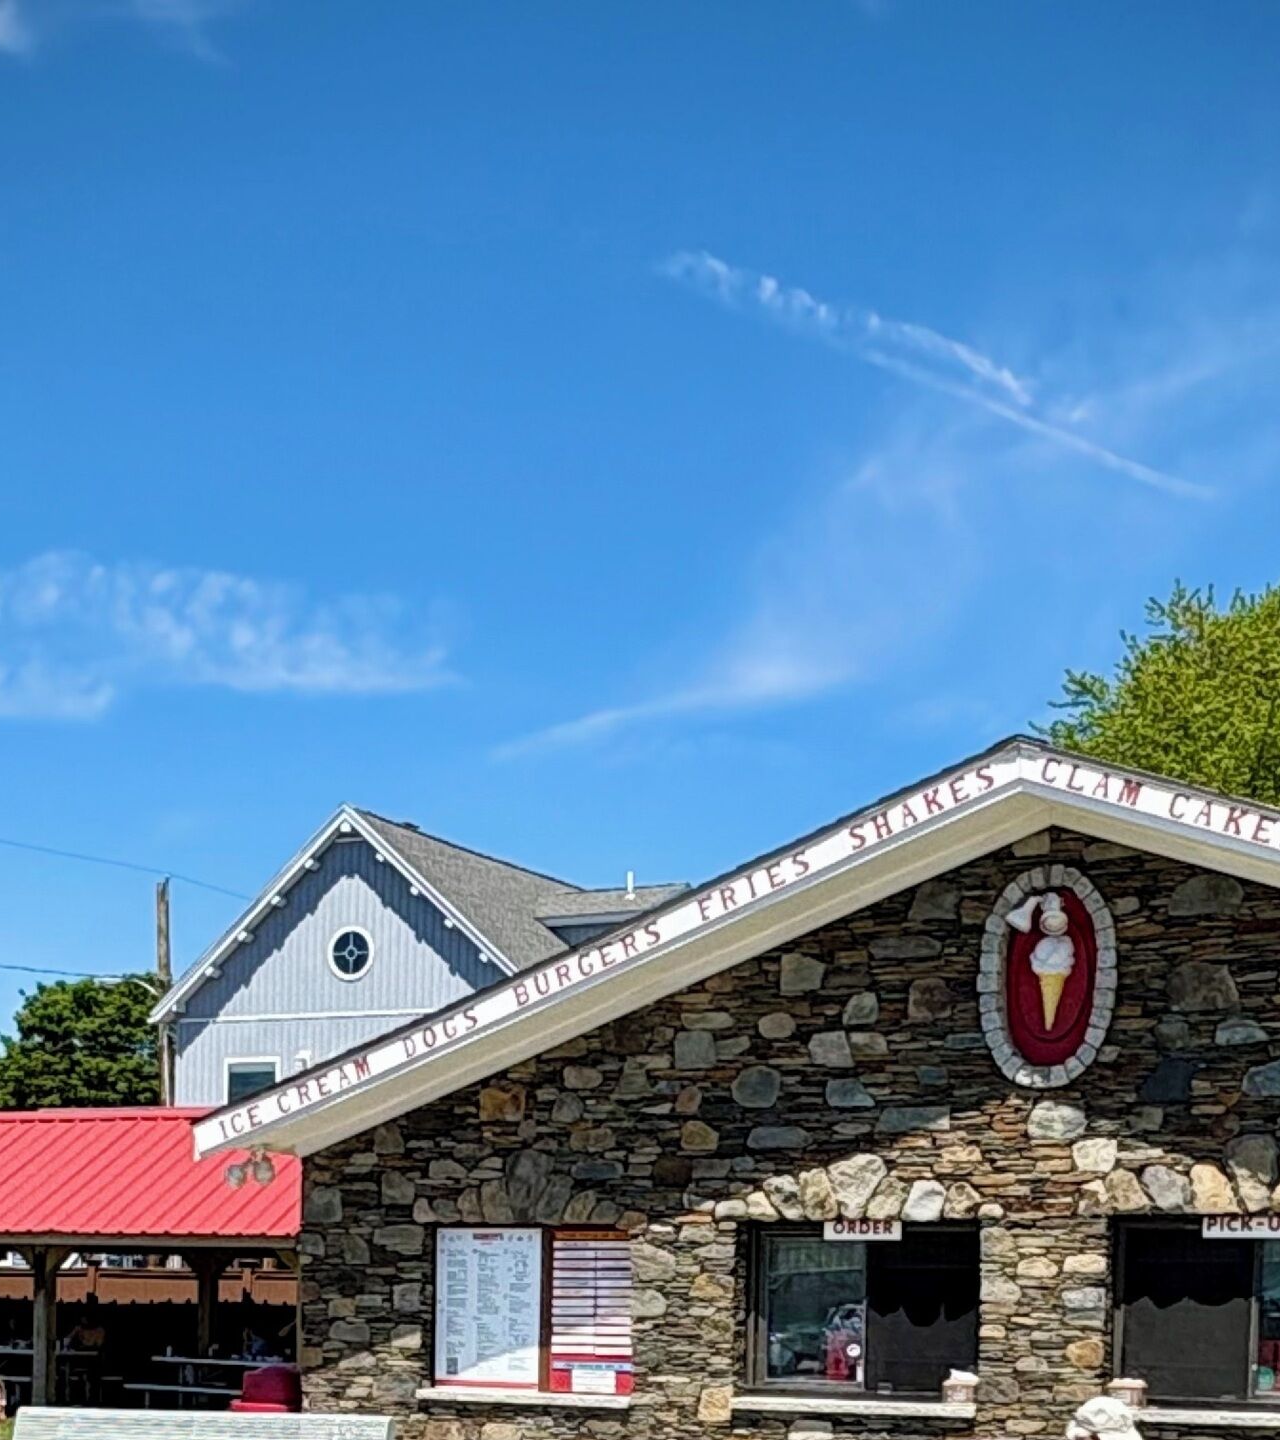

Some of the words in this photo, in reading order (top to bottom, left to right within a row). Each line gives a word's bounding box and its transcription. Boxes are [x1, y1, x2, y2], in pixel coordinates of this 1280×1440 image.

[1040, 757, 1143, 807] CLAM
[219, 1105, 263, 1140] ICE
[276, 1055, 371, 1114] CREAM
[401, 1006, 479, 1060] DOGS
[513, 920, 662, 1007] BURGERS
[697, 849, 811, 922] FRIES
[849, 764, 995, 850] SHAKES
[832, 1218, 894, 1235] ORDER
